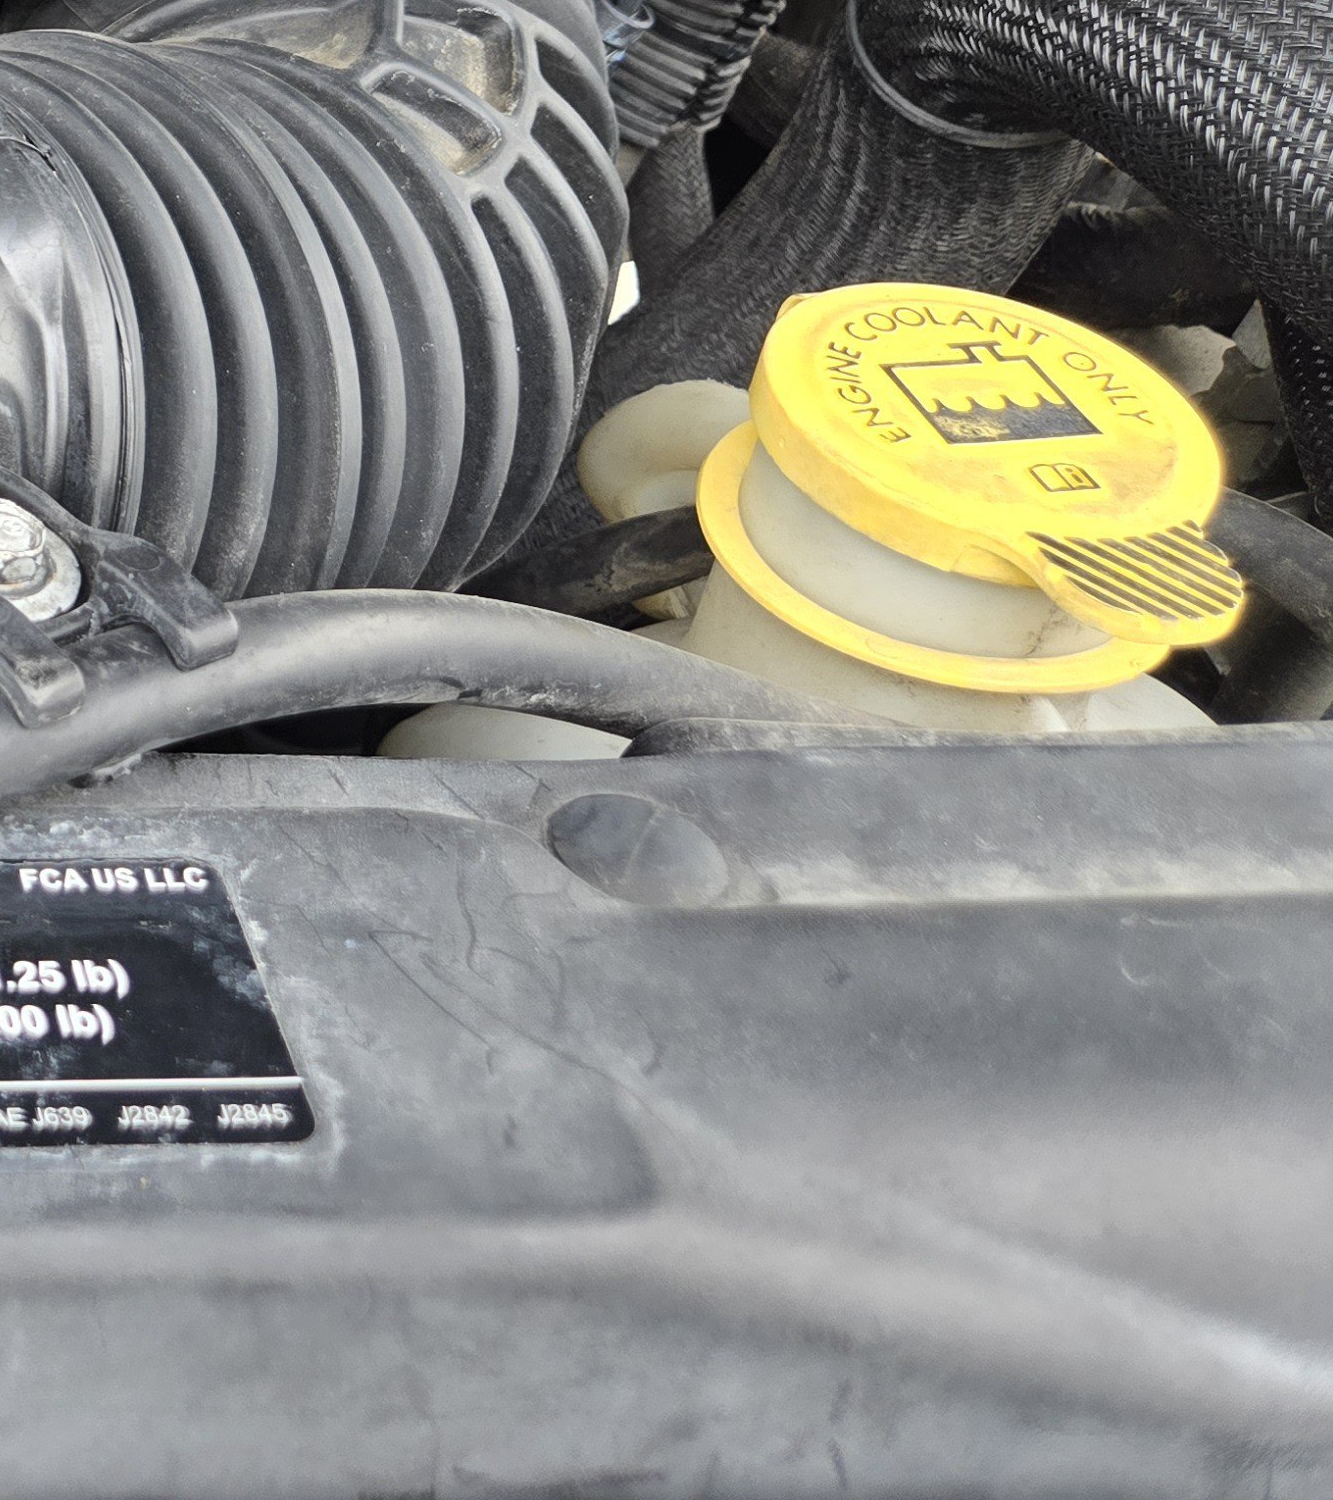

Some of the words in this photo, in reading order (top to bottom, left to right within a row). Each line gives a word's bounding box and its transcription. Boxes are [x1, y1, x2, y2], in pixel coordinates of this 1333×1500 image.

[844, 306, 1049, 346] COOLANT
[826, 341, 912, 443] ENGINE
[1063, 351, 1154, 425] ONLY
[19, 868, 88, 892] FCA
[92, 868, 138, 892] US
[144, 867, 209, 891] LLC
[71, 959, 130, 1000] lb)
[54, 1004, 115, 1045] lb)
[32, 1105, 93, 1130] J639
[117, 1105, 192, 1129] J2842
[217, 1102, 293, 1128] J2845
